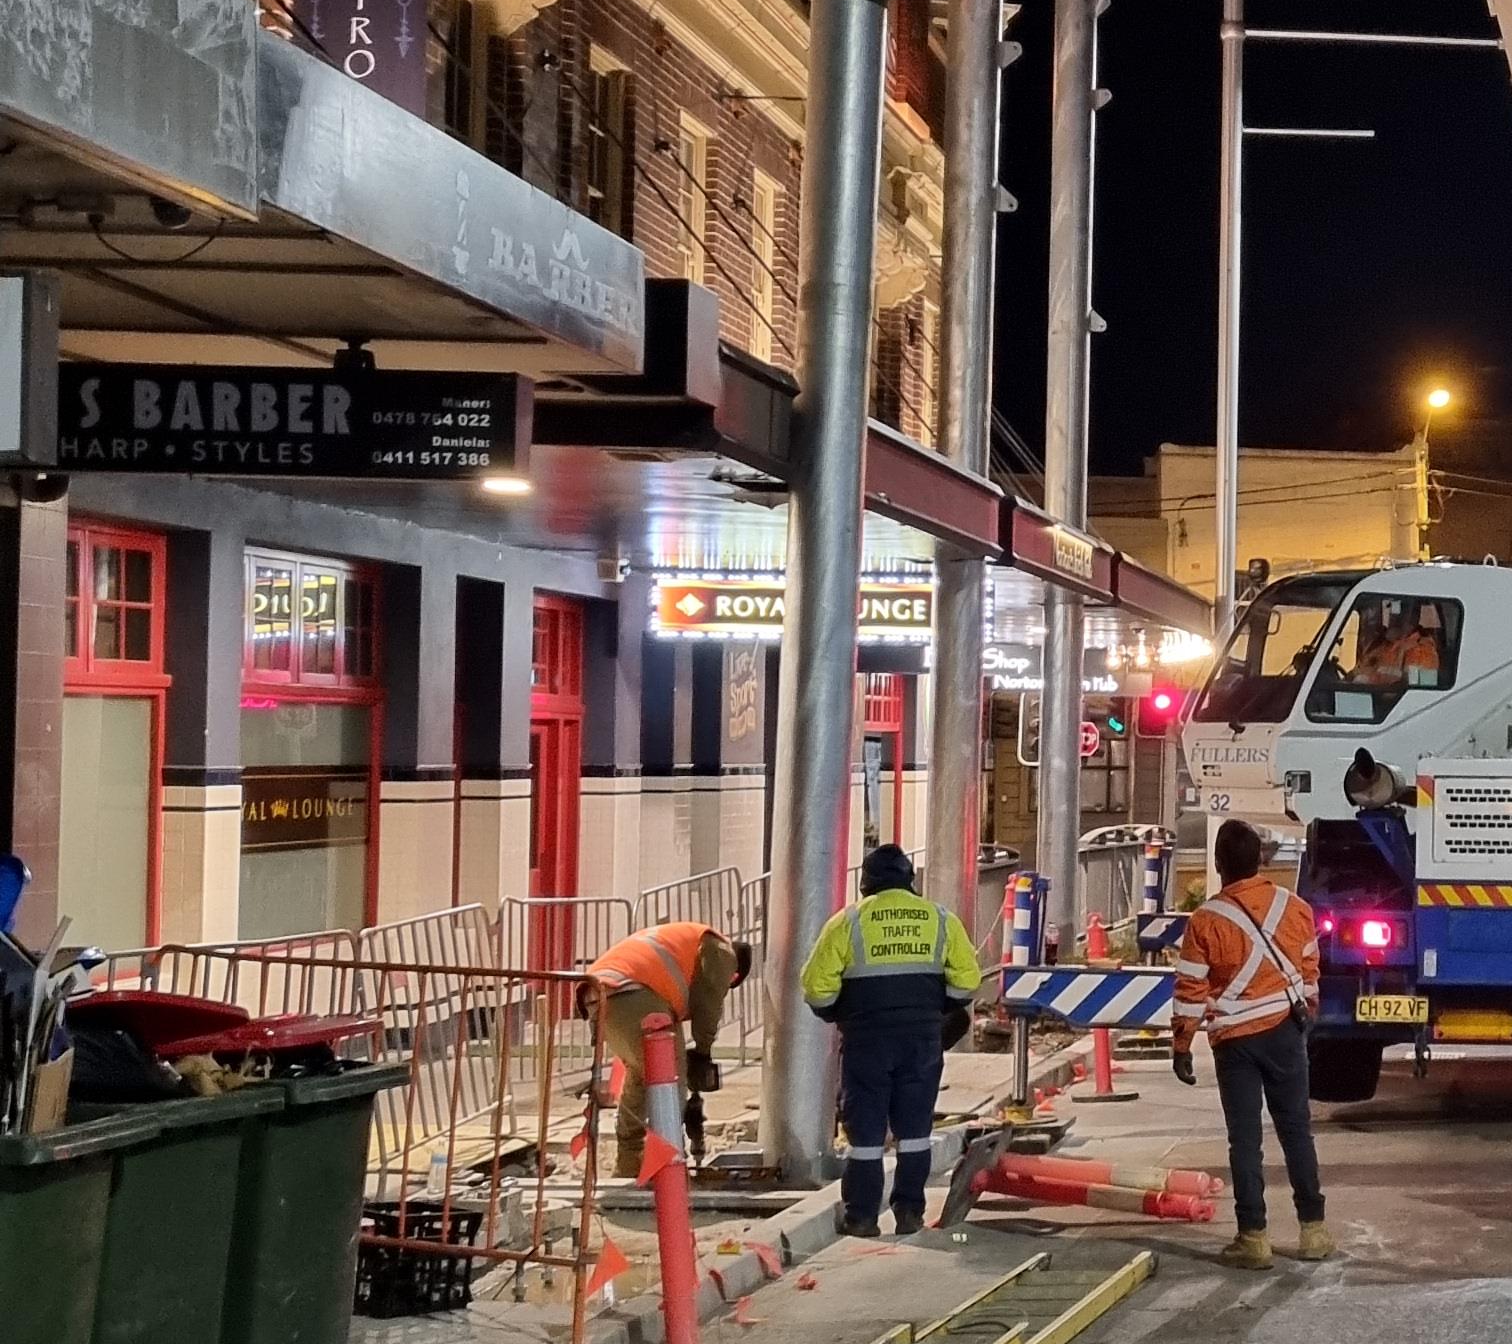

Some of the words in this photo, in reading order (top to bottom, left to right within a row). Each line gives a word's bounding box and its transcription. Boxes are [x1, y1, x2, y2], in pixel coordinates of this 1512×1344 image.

[133, 379, 351, 435] BARBER
[457, 413, 491, 427] 022
[61, 438, 149, 458] HARP
[192, 440, 314, 464] STYLES
[372, 451, 414, 464] 0411
[420, 452, 453, 465] 517
[458, 452, 491, 466] 386
[715, 595, 786, 618] ROYA
[858, 598, 927, 621] UNGE
[982, 647, 1030, 674] Shop
[1081, 732, 1097, 745] TOP
[1191, 747, 1270, 763] FULLERS
[291, 796, 354, 820] LOUNGE
[1210, 793, 1230, 811] 32
[871, 908, 929, 922] AUTHORISED
[882, 925, 921, 937] TRAFFIC
[871, 943, 931, 957] CONTROLLER
[1359, 998, 1378, 1016] CH
[1383, 1000, 1402, 1016] 92
[1408, 999, 1427, 1016] VF
